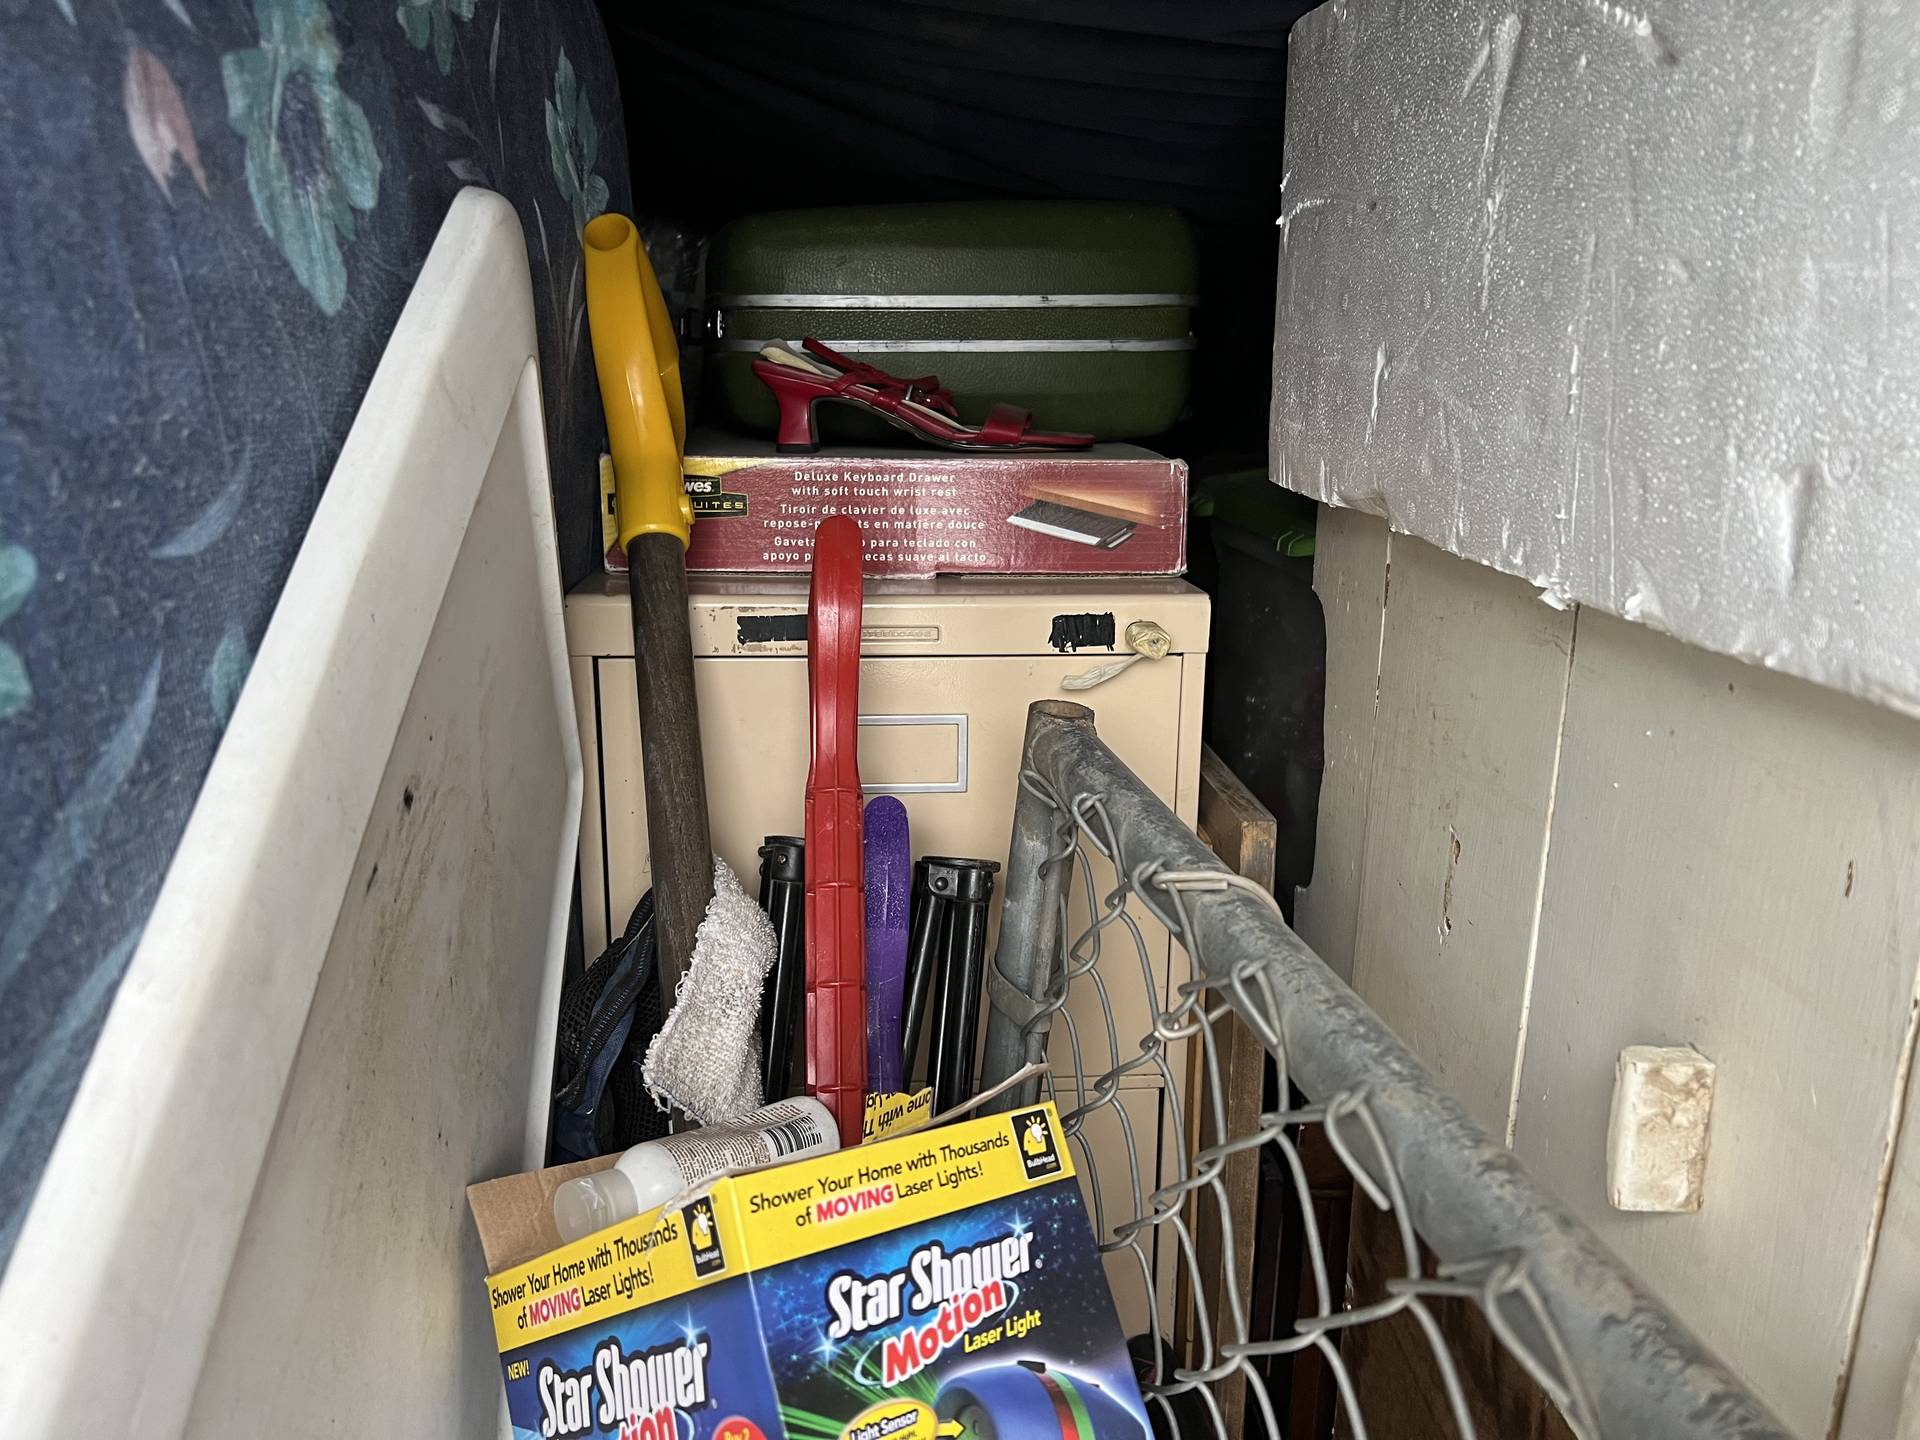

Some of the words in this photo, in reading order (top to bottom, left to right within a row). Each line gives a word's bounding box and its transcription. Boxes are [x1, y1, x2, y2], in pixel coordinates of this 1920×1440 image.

[791, 485, 820, 496] with
[824, 485, 849, 496] soft
[853, 486, 889, 497] touch
[893, 486, 927, 497] wrist
[931, 487, 957, 497] rest
[794, 471, 839, 482] Deluxe
[843, 471, 904, 484] Keyboard
[908, 473, 956, 483] Drawer
[780, 504, 817, 515] Tiroir
[821, 504, 837, 515] de
[841, 504, 886, 515] clavier
[890, 505, 906, 516] de
[910, 505, 937, 516] luxe
[942, 507, 970, 516] avec
[874, 520, 889, 529] en
[948, 520, 985, 530] douce
[762, 552, 800, 563] apoyo
[897, 553, 934, 563] suave
[937, 552, 950, 563] al
[954, 553, 987, 563] tacto
[870, 539, 899, 550] para
[903, 538, 951, 549] teclado
[955, 540, 976, 549] con
[878, 1105, 904, 1132] with
[749, 1184, 813, 1214] Shower
[817, 1174, 855, 1197] Your
[858, 1160, 903, 1186] Home
[905, 1151, 939, 1178] with
[939, 1132, 1010, 1163] Thousands
[795, 1204, 815, 1227] of
[816, 1184, 895, 1223] MOVING
[896, 1178, 934, 1199] Laser
[937, 1164, 985, 1191] Lights!
[492, 1281, 527, 1310] Shower
[527, 1270, 551, 1293] Your
[552, 1258, 587, 1284] Home
[587, 1242, 614, 1273] with
[613, 1219, 679, 1262] Thousands
[517, 1308, 529, 1330] of
[529, 1287, 582, 1327] MOVING
[581, 1281, 611, 1308] Laser
[612, 1261, 655, 1301] Lights!
[828, 1273, 906, 1339] Star
[910, 1231, 1034, 1311] Shower
[883, 1280, 1006, 1387] Motion
[963, 1327, 1002, 1354] Laser
[1005, 1309, 1042, 1338] Light
[507, 1359, 531, 1381] NEW!
[538, 1366, 592, 1439] Star
[596, 1342, 708, 1427] Shower
[880, 1410, 918, 1436] Sensor
